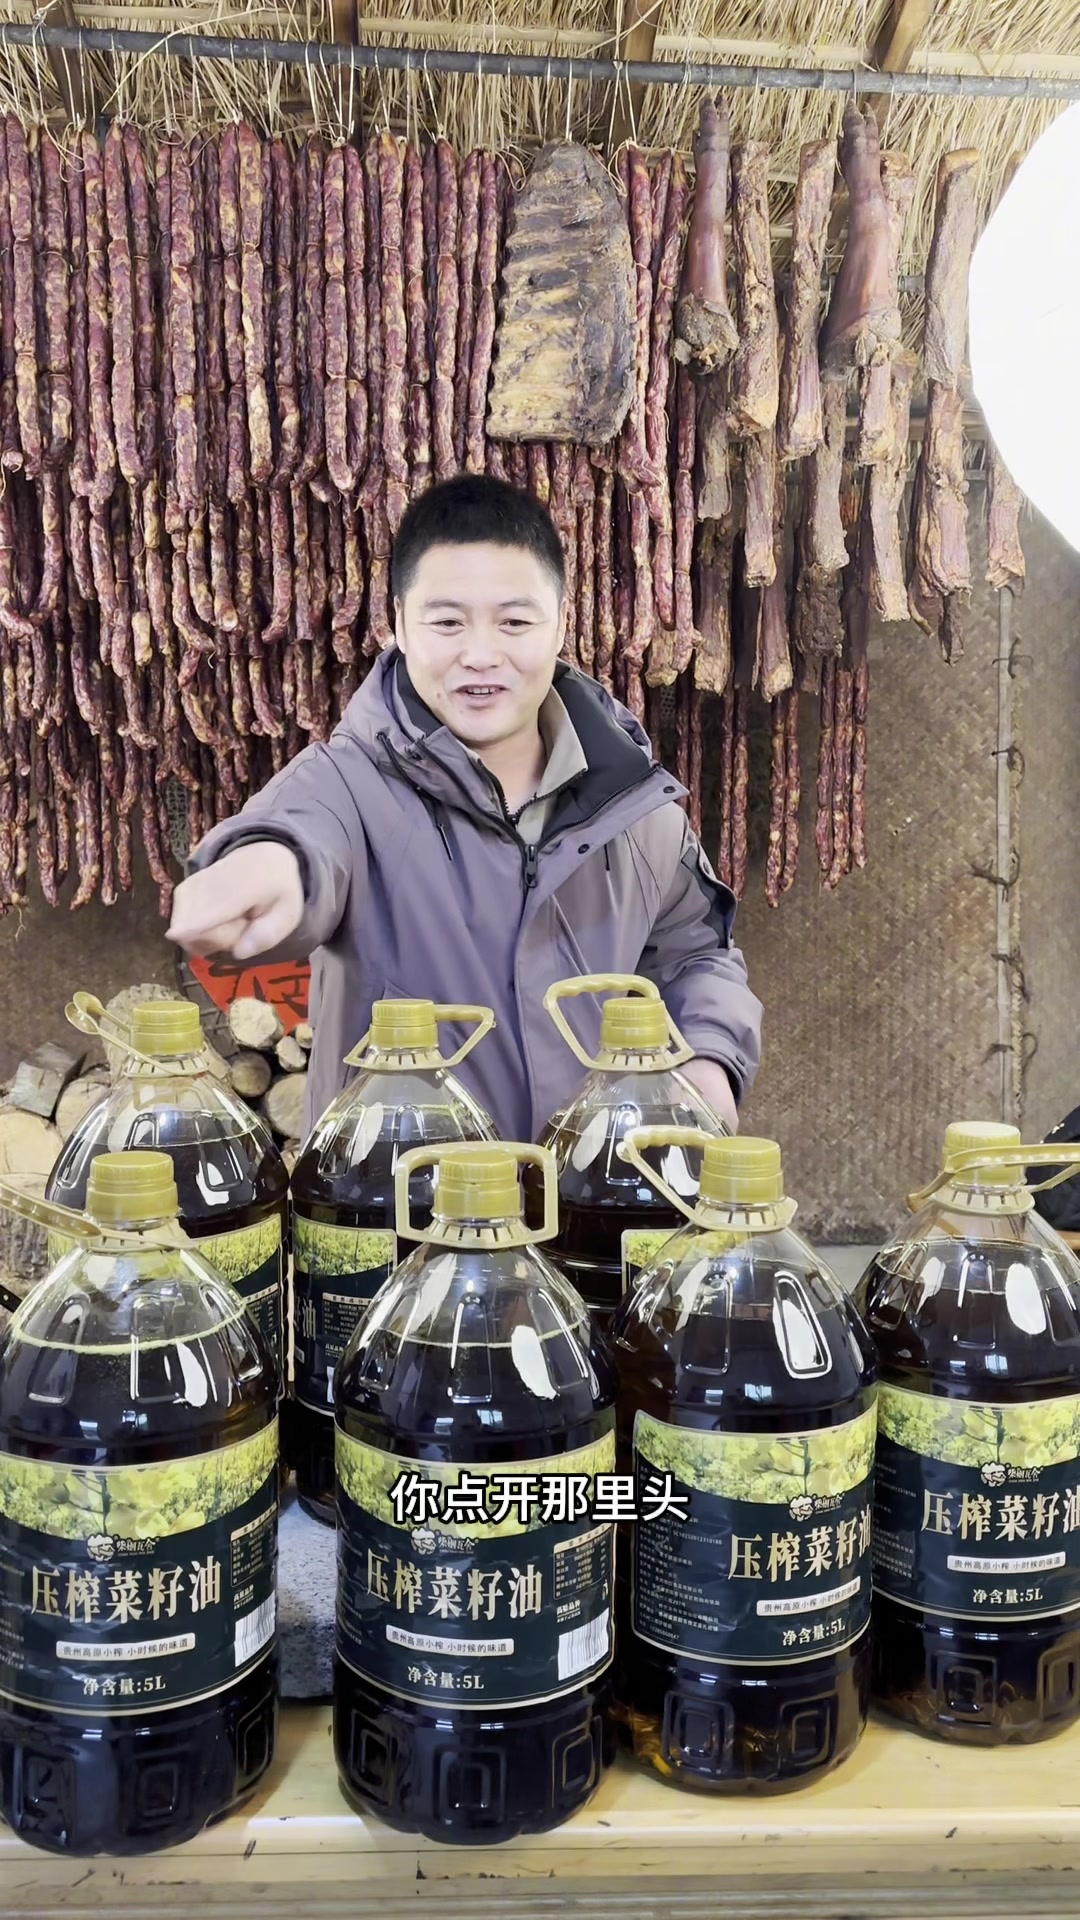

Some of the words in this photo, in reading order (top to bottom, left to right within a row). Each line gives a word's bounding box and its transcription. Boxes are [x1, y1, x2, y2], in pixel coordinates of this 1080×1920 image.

[921, 1485, 1080, 1542] 压榨菜籽油
[727, 1503, 872, 1583] 压榨菜籽油
[31, 1555, 222, 1625] 压榨菜籽油
[366, 1548, 543, 1622] 压榨菜籽油
[972, 1587, 1043, 1605] 净含量:5L
[782, 1616, 846, 1648] 净含量:5L
[82, 1675, 167, 1697] 净含量:5L
[407, 1665, 485, 1691] 净含量:5L
